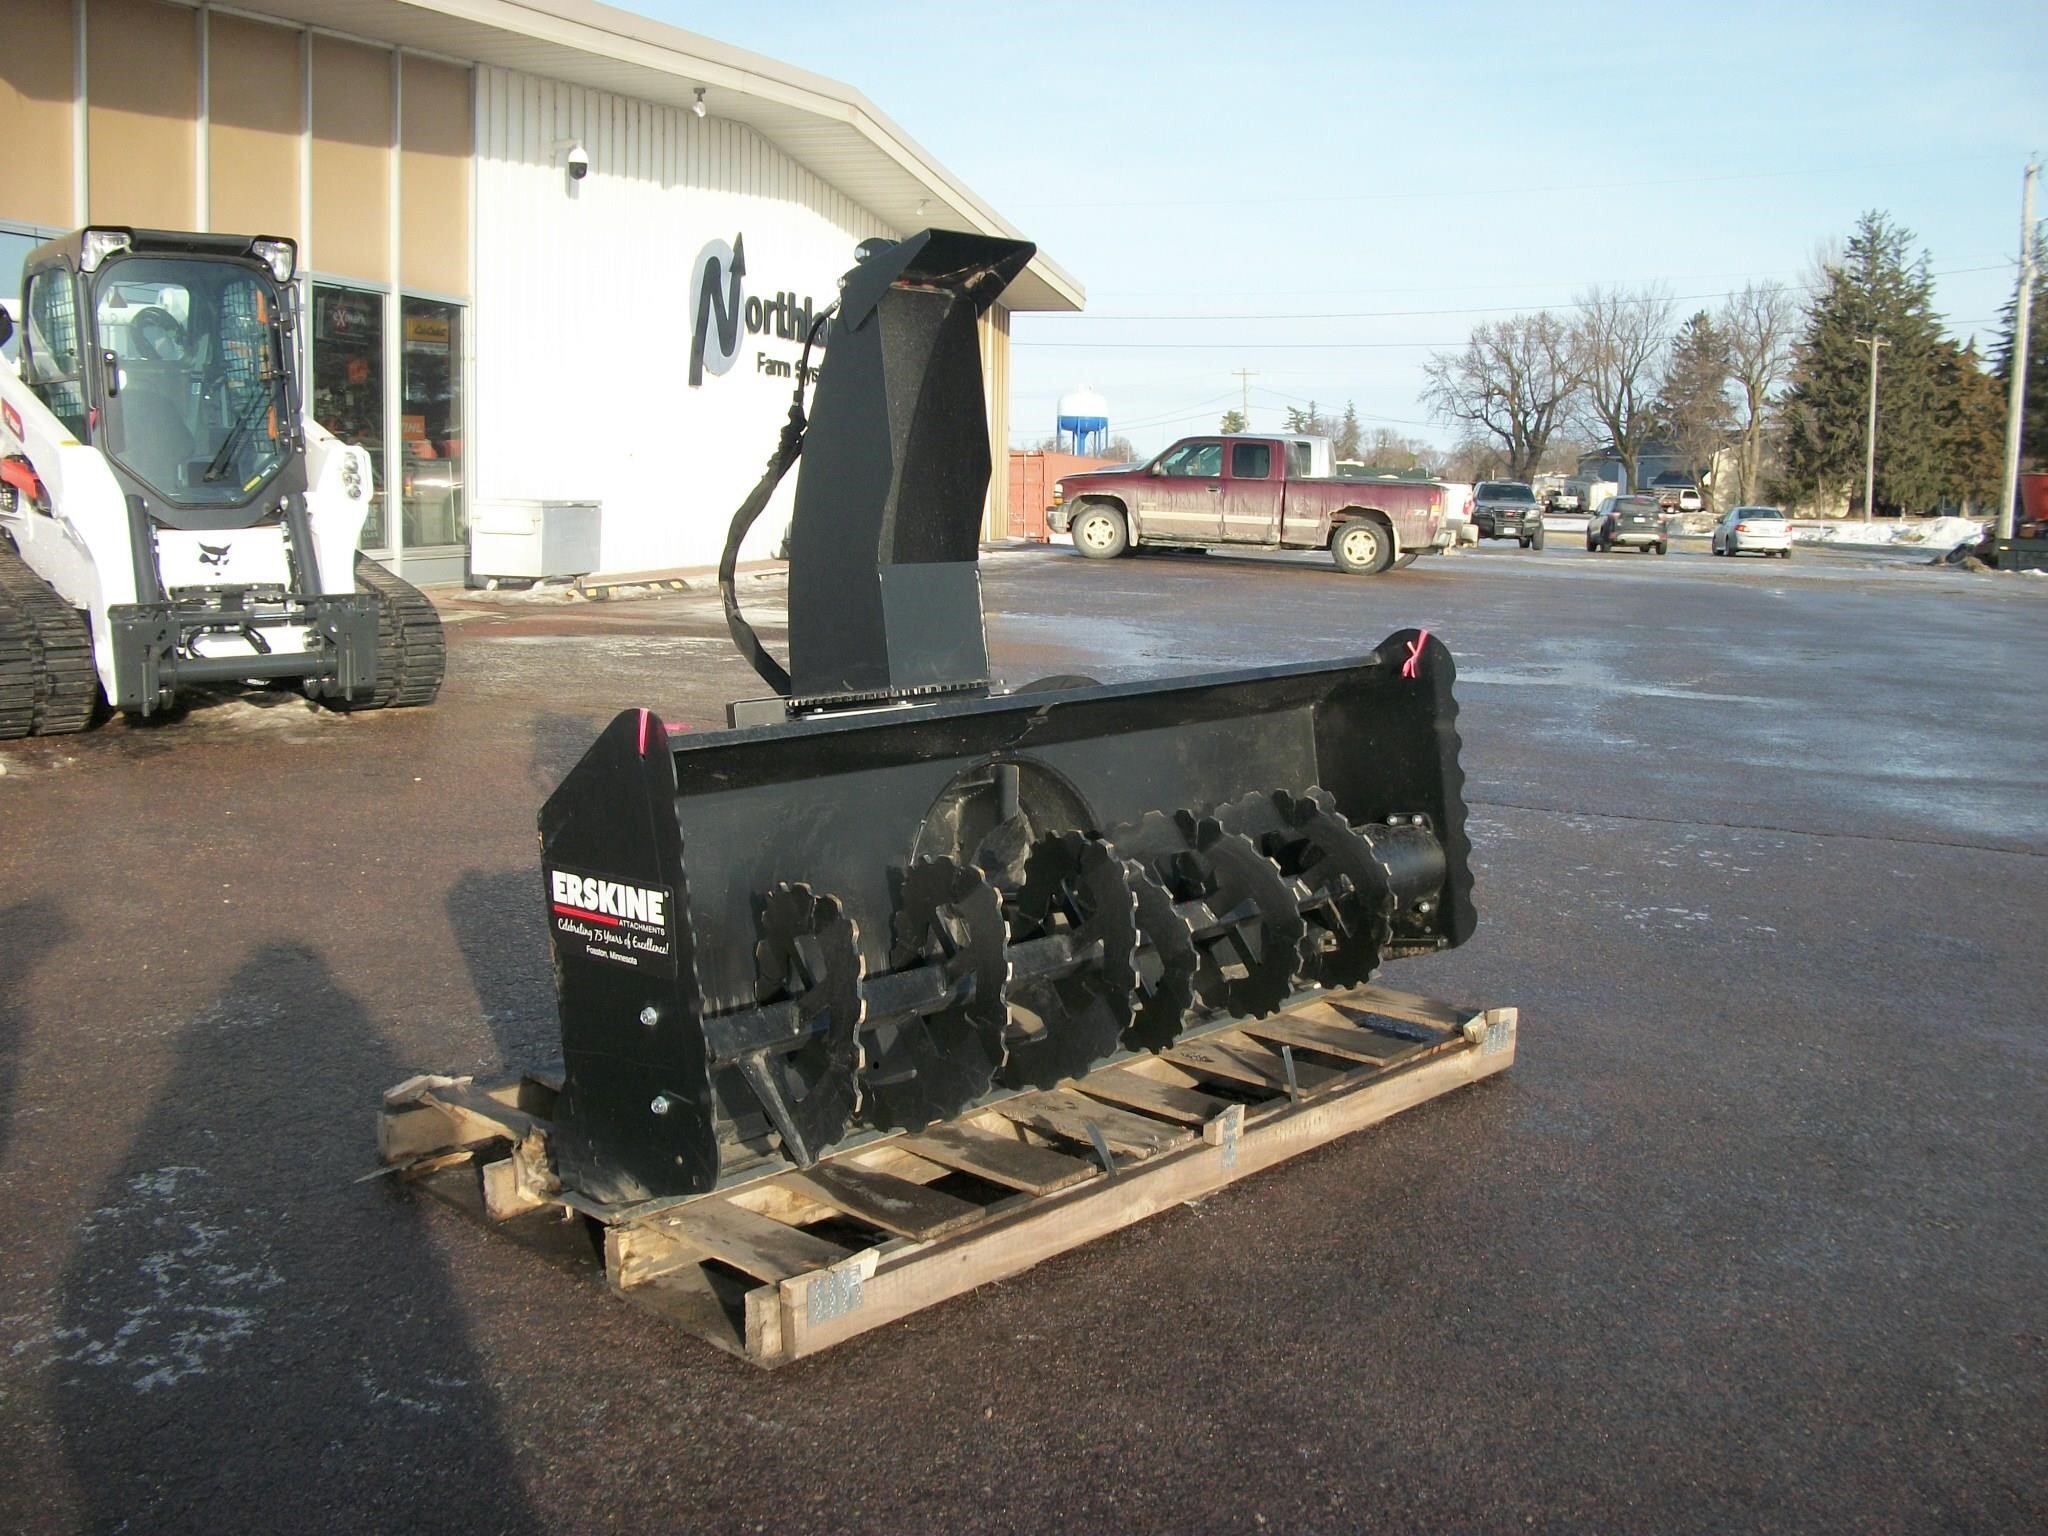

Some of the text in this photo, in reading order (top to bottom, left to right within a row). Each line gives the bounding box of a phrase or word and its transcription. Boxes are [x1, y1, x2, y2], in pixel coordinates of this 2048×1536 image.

[688, 232, 829, 388] Northla
[552, 870, 665, 926] ERSKINE
[558, 918, 669, 954] Celebrating 75 Years of Excellence!
[619, 919, 665, 936] ATTACHMENTS
[609, 950, 638, 965] Minnesota
